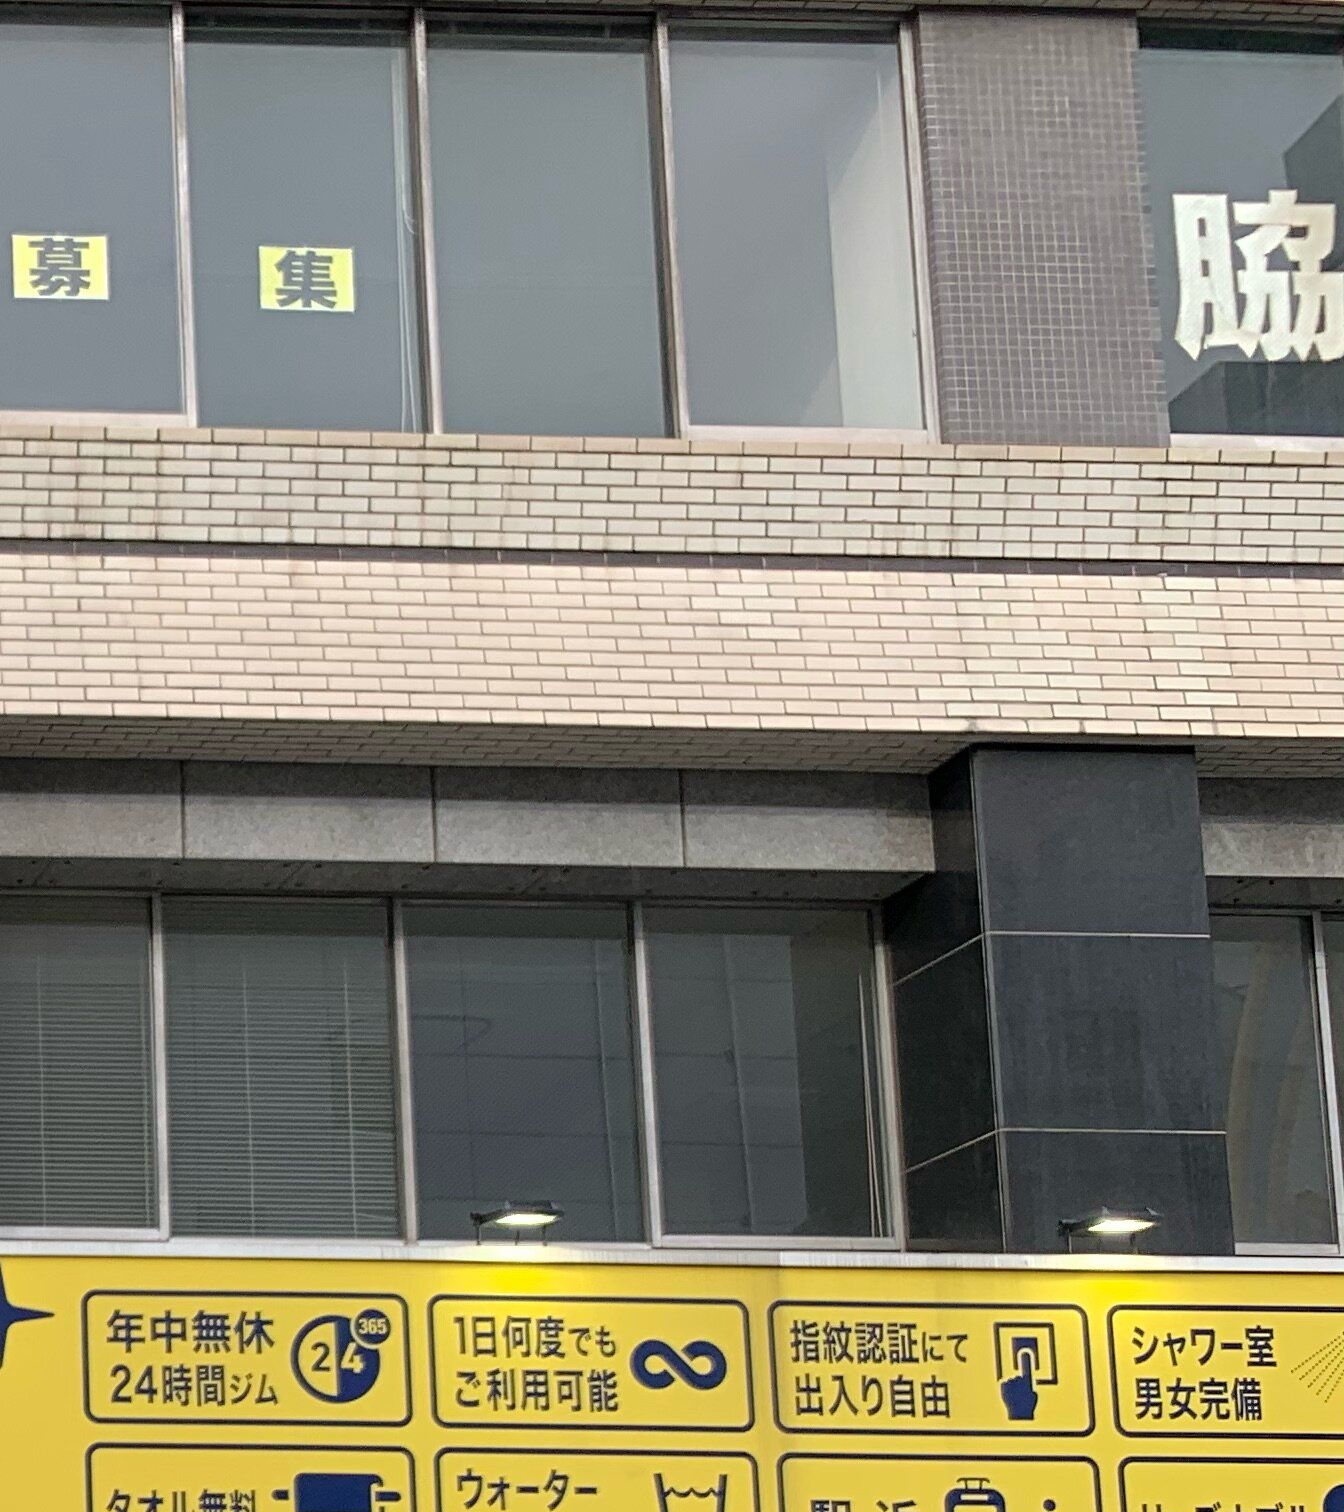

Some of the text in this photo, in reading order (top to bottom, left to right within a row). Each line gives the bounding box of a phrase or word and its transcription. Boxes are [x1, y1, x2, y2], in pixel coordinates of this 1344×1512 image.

[1172, 189, 1344, 362] 脇
[106, 1309, 275, 1355] 年中無休
[357, 1317, 389, 1337] 365
[454, 1314, 617, 1361] 1日何度でも
[789, 1320, 969, 1365] 指紋認証にて
[1131, 1324, 1278, 1370] シャワー室
[111, 1363, 279, 1408] 24時間ジム
[456, 1367, 620, 1413] ご利用可能
[794, 1375, 951, 1419] 出入り自由
[1135, 1376, 1264, 1422] 男女完備
[456, 1468, 599, 1512] ウォーター
